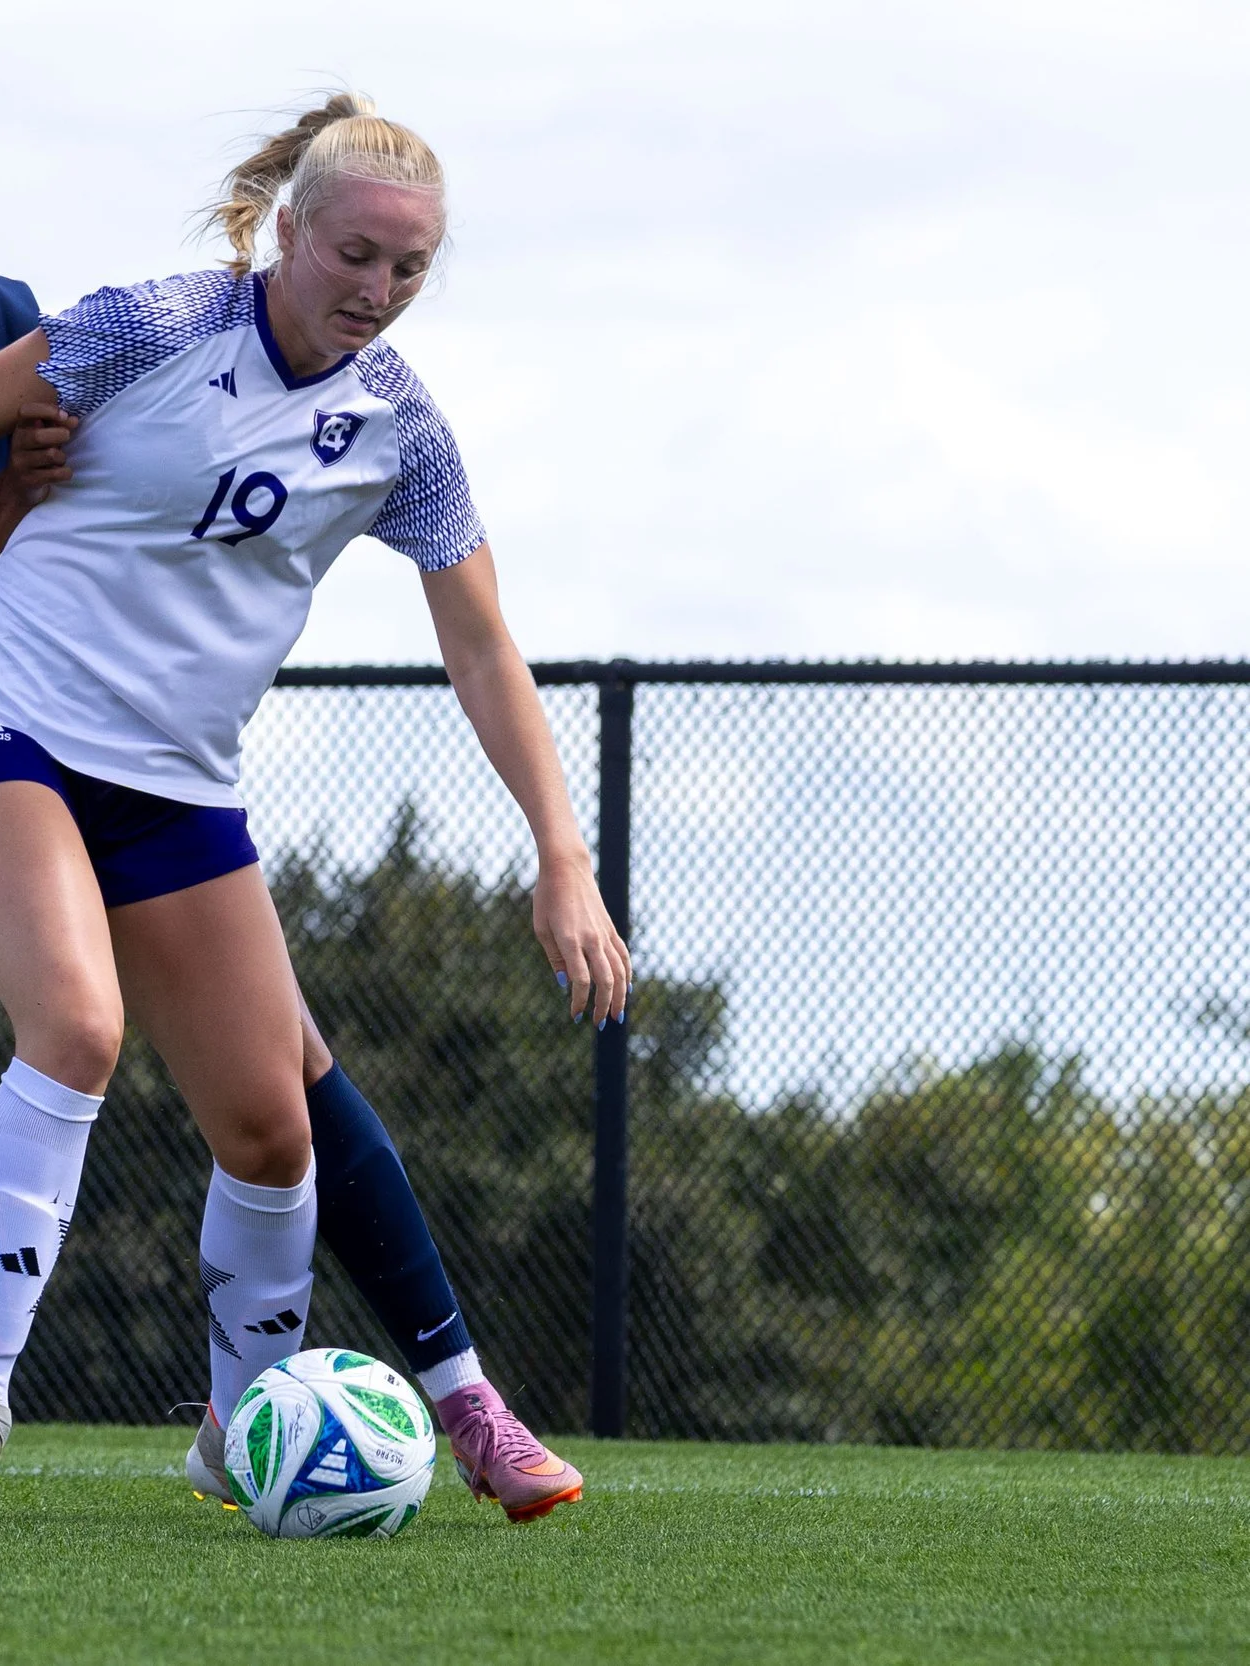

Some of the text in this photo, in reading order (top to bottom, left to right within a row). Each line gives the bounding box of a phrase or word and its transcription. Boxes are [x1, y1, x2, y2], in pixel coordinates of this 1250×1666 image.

[190, 465, 289, 548] 19
[375, 1448, 390, 1460] PRO
[390, 1454, 403, 1466] MLS
